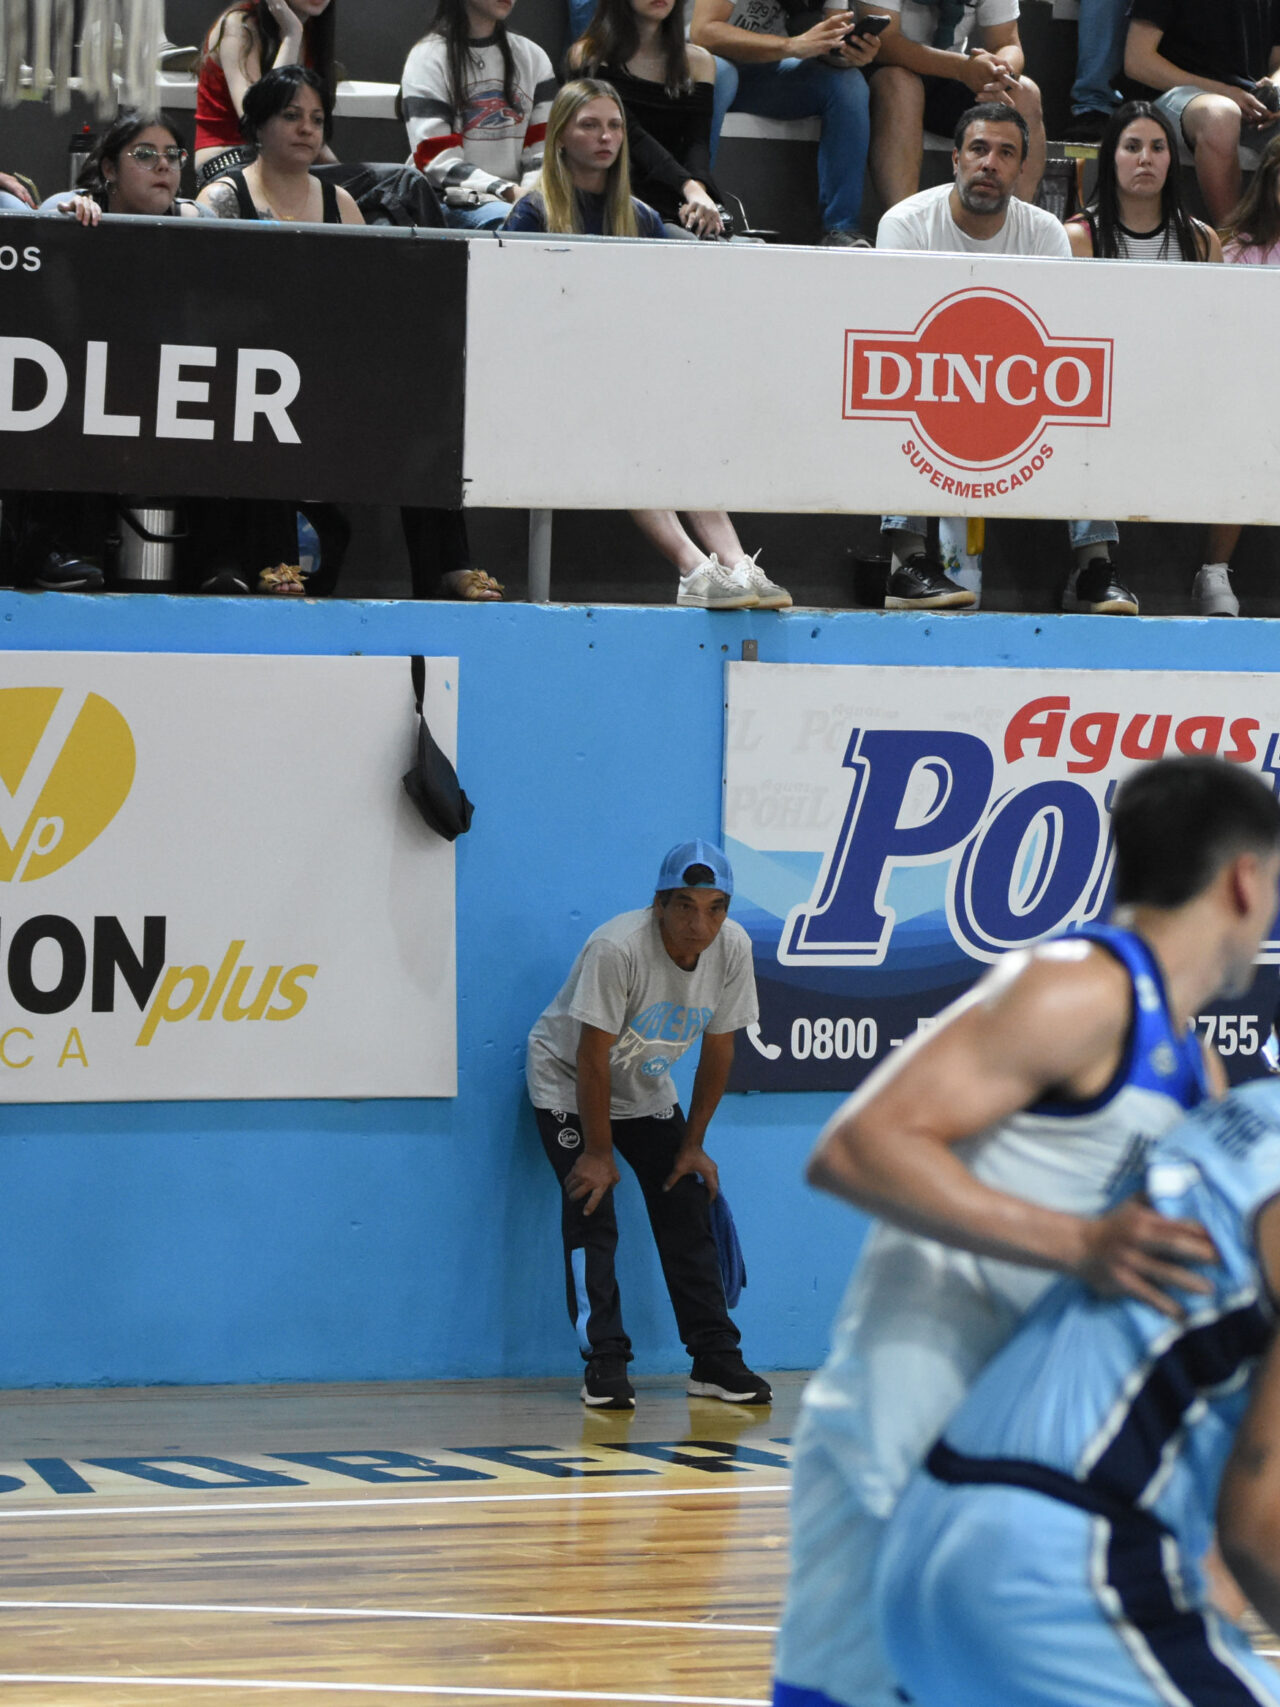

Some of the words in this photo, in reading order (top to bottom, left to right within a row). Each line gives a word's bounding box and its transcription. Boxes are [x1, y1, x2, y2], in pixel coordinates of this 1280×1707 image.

[861, 350, 1092, 407] DINCO
[901, 439, 1055, 499] SUPERMERCADOS
[1003, 696, 1260, 773] Aguas
[790, 1017, 878, 1060] 0800
[1187, 1014, 1259, 1056] 755
